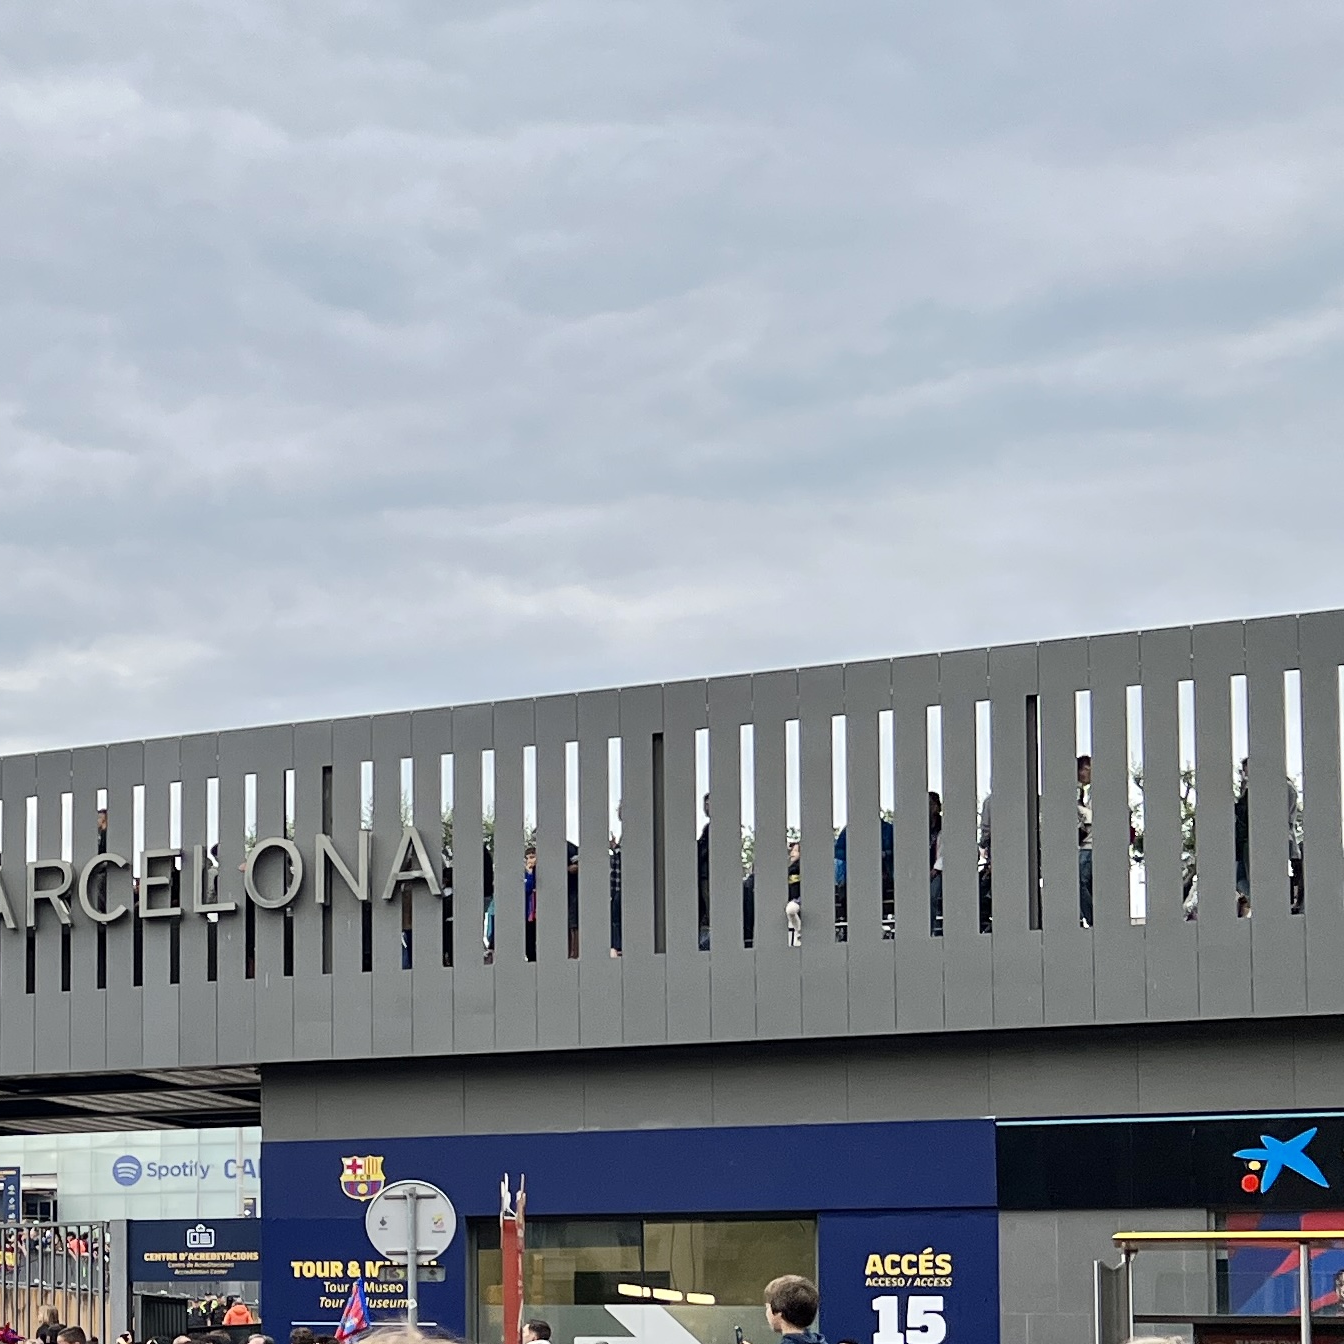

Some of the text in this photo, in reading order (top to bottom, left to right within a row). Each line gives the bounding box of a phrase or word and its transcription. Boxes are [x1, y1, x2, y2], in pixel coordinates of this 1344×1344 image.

[146, 1158, 262, 1180] Spotify CA
[143, 1252, 178, 1262] CENTRE
[864, 1246, 952, 1276] ACCÉS
[290, 1260, 344, 1278] TOUR
[346, 1260, 362, 1278] &
[323, 1281, 404, 1293] Tour Museo
[865, 1277, 953, 1287] ACCESO / ACCESS
[319, 1296, 346, 1309] Tour
